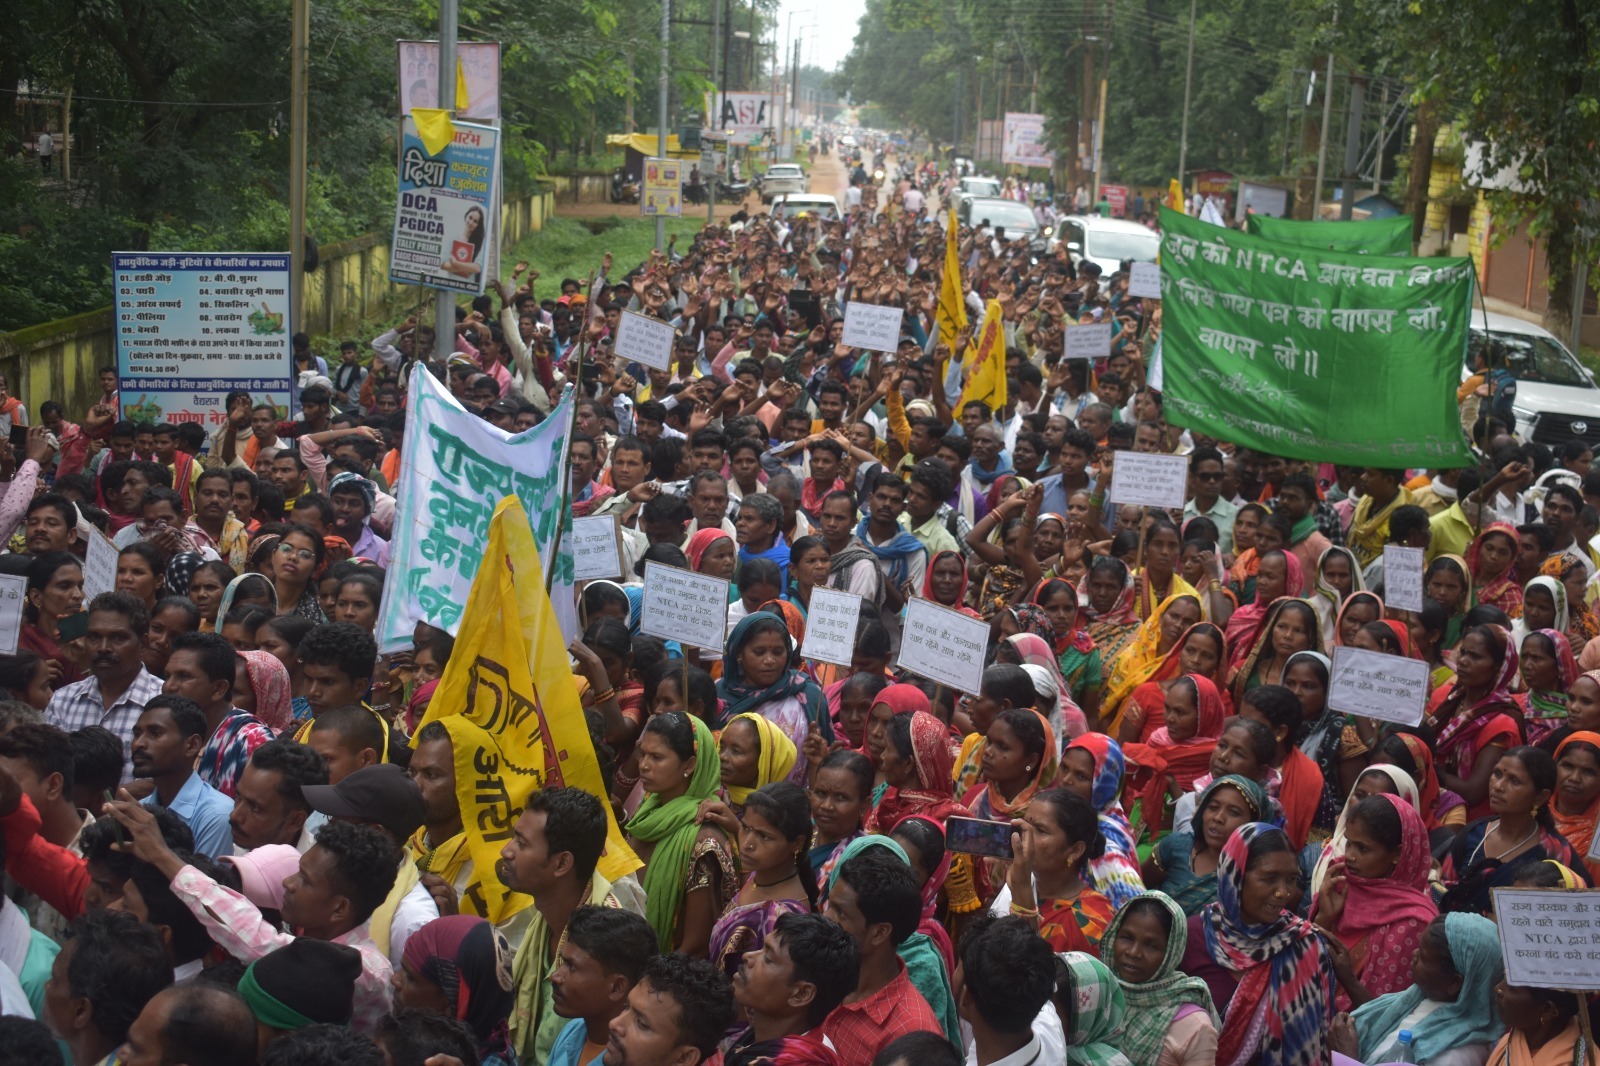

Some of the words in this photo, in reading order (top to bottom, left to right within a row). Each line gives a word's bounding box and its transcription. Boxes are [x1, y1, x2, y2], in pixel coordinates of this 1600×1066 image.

[404, 149, 447, 187] दिशा
[401, 192, 438, 213] DCA
[399, 216, 445, 236] PGDCA
[397, 238, 416, 250] TALLY
[417, 242, 440, 254] PRIME
[205, 258, 211, 267] से
[249, 259, 260, 267] का
[262, 259, 285, 267] उपचार
[412, 253, 441, 267] COMPUTER
[1235, 248, 1309, 281] NTCA
[1317, 262, 1361, 288] द्वारा
[1361, 267, 1403, 287] वन
[136, 312, 165, 321] पीलिया
[1295, 298, 1327, 331] को
[1331, 309, 1398, 334] वापस
[1199, 327, 1264, 360] वापस
[167, 409, 206, 426] गणेश
[657, 596, 679, 609] NTCA
[1510, 902, 1533, 911] राज्य
[1536, 903, 1568, 912] सरकार
[1572, 901, 1589, 913] और
[1510, 915, 1531, 927] रहने
[1535, 915, 1553, 927] वाले
[1558, 919, 1590, 931] समुदाय
[1524, 933, 1563, 945] NTCA
[1567, 935, 1588, 947] द्वारा
[1514, 949, 1541, 959] करना
[1544, 948, 1559, 960] बंद
[1563, 948, 1582, 960] करो
